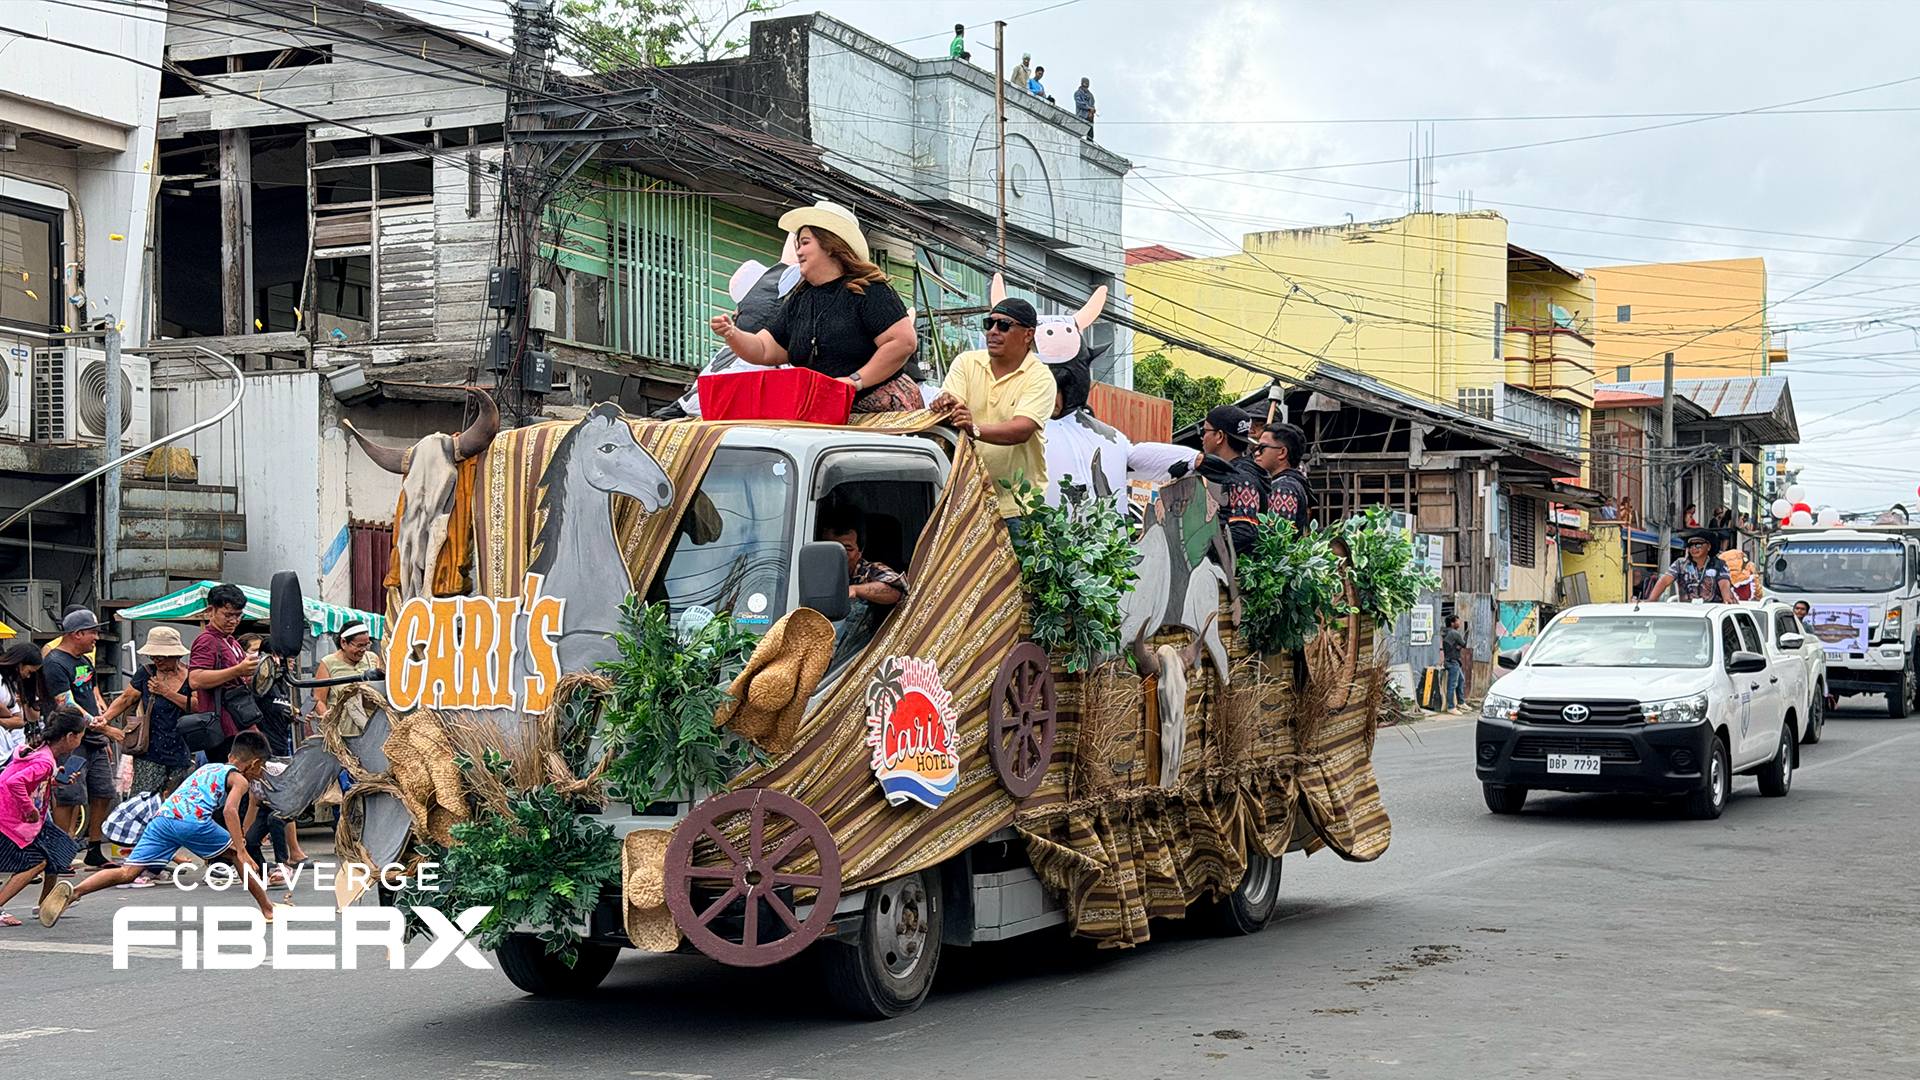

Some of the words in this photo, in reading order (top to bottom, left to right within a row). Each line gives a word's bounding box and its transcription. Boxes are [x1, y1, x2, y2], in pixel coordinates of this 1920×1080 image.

[386, 572, 566, 715] CARI'S
[881, 707, 956, 770] Cari's
[916, 753, 954, 772] HOTEL
[1549, 758, 1567, 770] DBP
[1573, 759, 1599, 771] 7792
